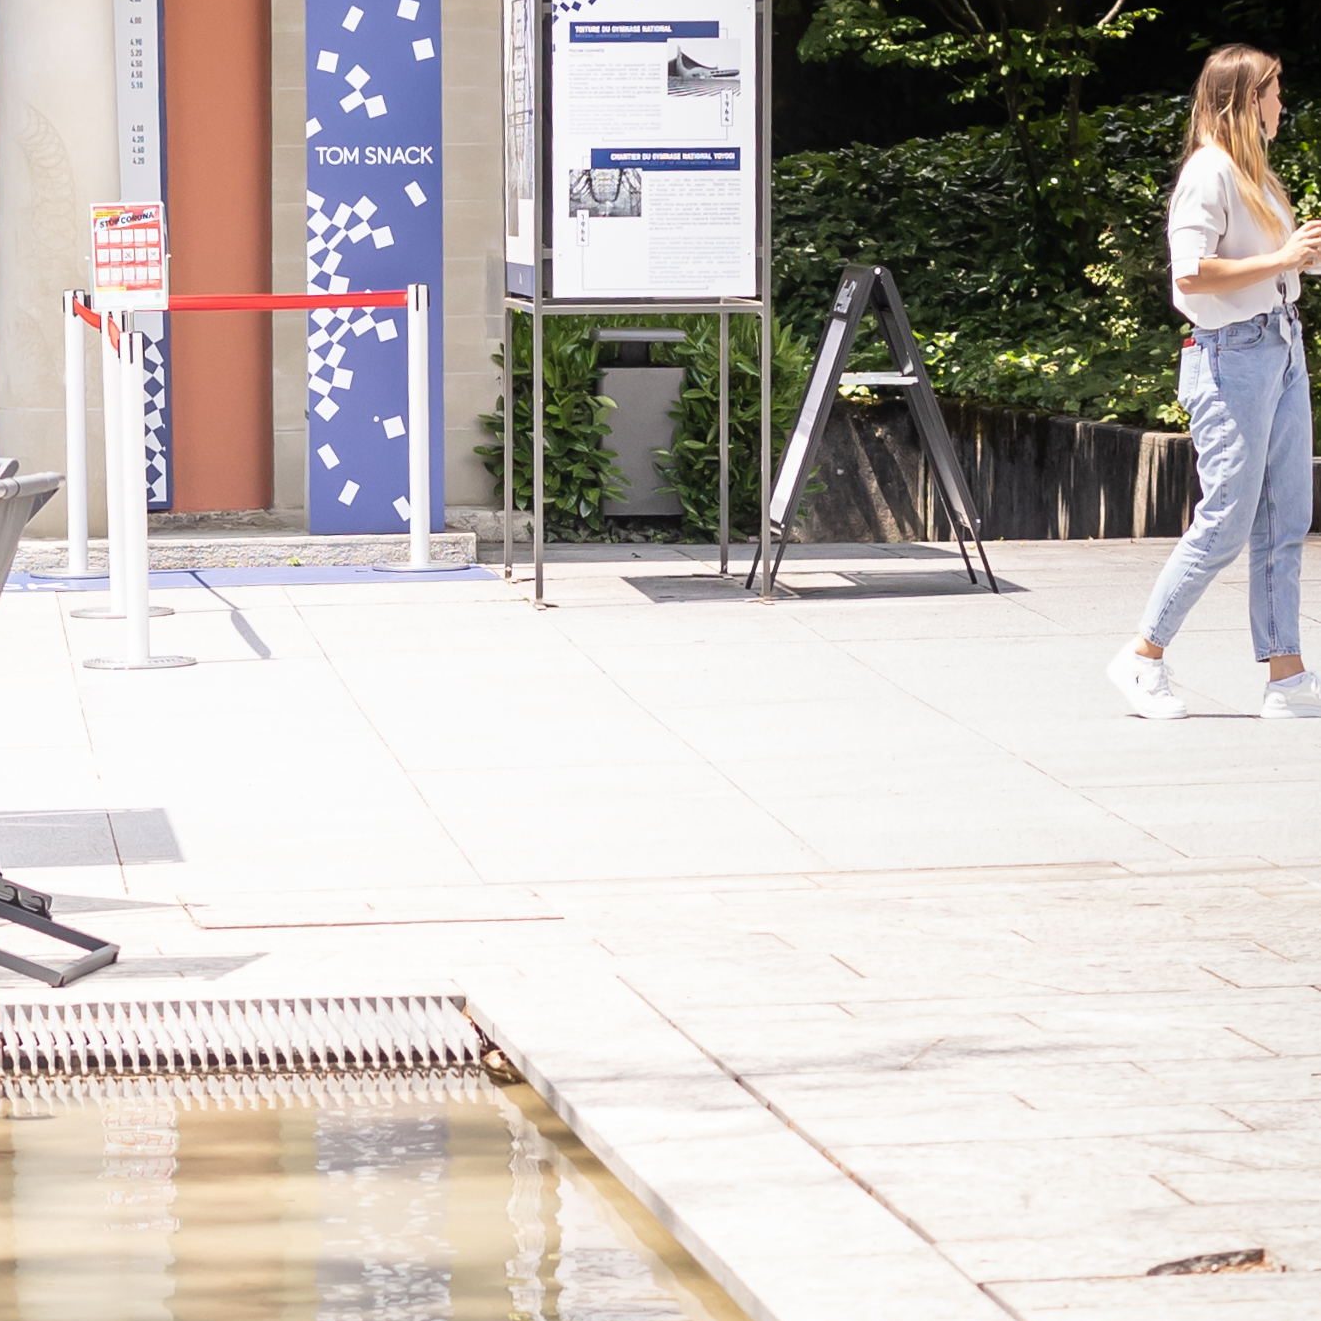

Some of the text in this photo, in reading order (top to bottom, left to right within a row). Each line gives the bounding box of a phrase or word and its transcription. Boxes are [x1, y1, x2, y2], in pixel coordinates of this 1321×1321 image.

[314, 146, 434, 165] TOM SNACK
[99, 217, 119, 229] STOP
